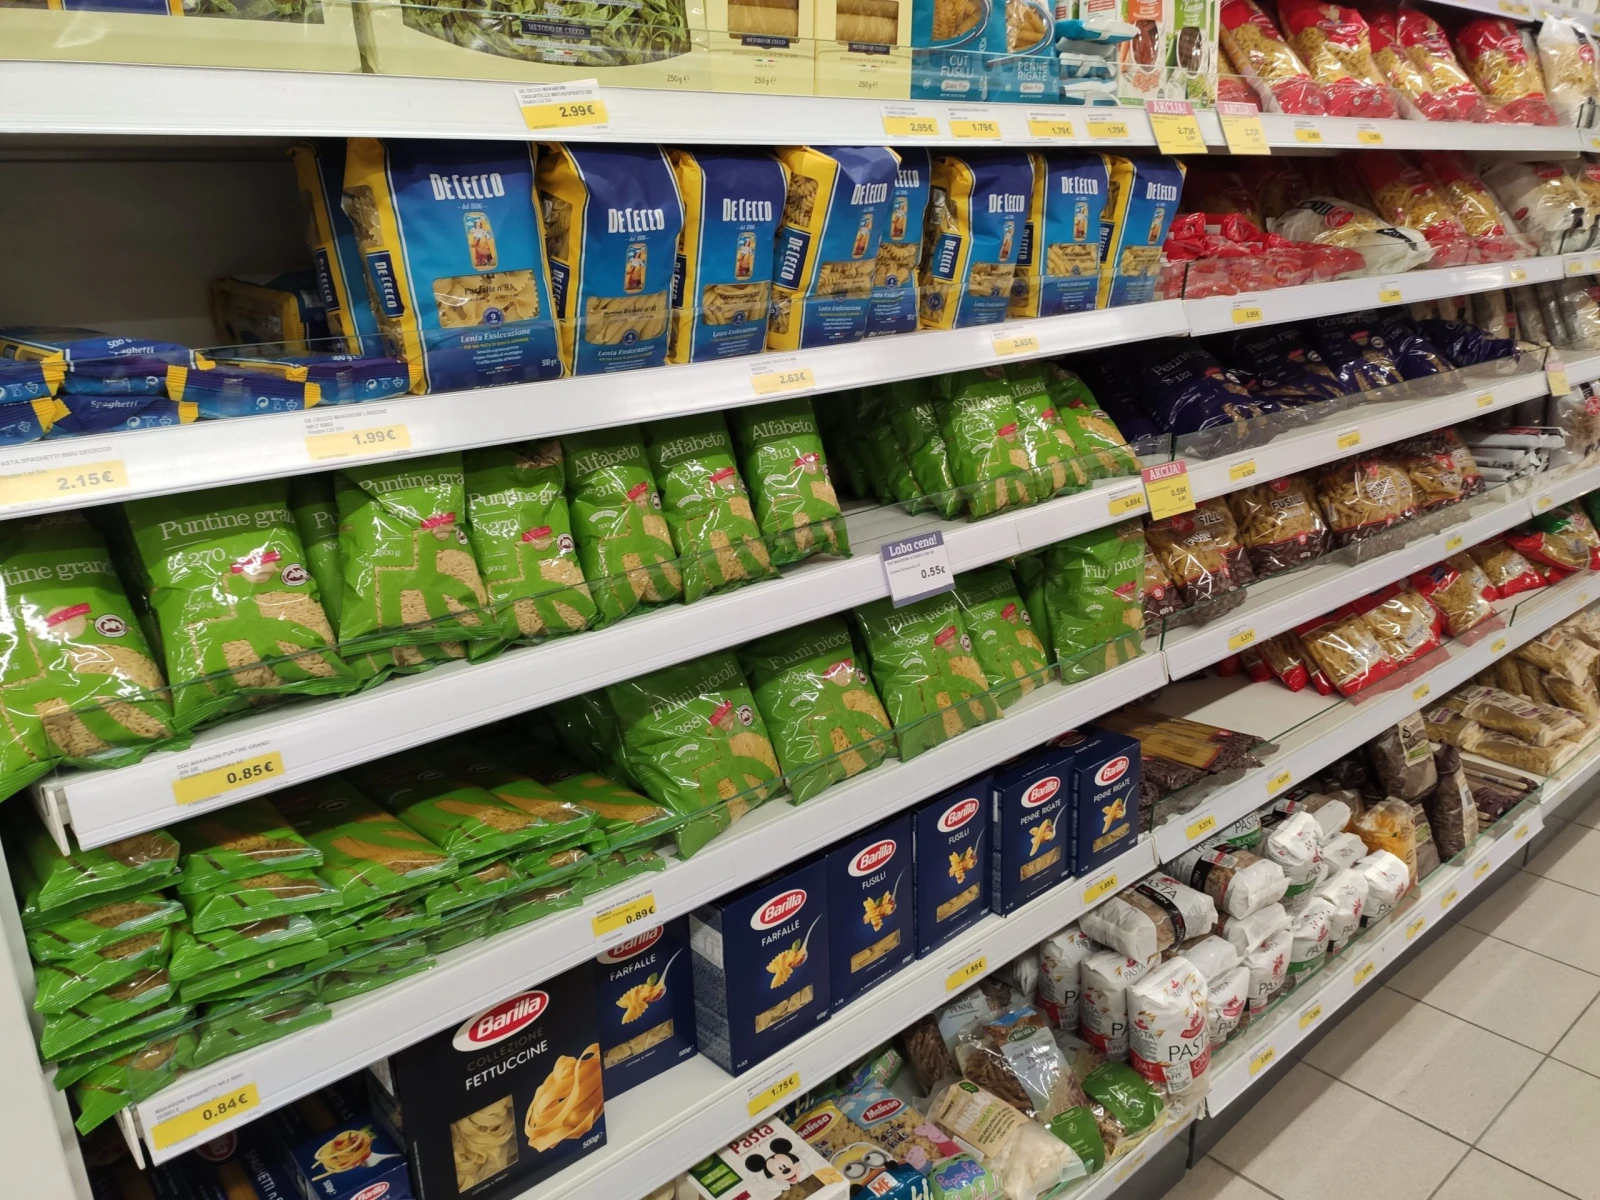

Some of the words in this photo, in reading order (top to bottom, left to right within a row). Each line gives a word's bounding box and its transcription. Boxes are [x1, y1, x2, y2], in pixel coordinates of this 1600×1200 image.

[949, 55, 969, 67] CUT
[1017, 61, 1048, 73] PENNE
[940, 65, 975, 79] FUSILLI
[1017, 71, 1048, 82] RIGATE
[559, 104, 595, 118] 2.99€
[1153, 101, 1188, 114] AKCIJA!
[460, 334, 483, 343] Lenta
[483, 328, 531, 341] Essiccazione
[90, 398, 138, 411] Spaghetti
[352, 429, 396, 446] 1.99€
[752, 420, 815, 440] Alfabeto
[659, 432, 726, 460] Alfabeto
[769, 448, 792, 461] 313
[20, 452, 61, 464] SPAGHETTI
[575, 445, 640, 478] Alfabeto
[56, 470, 115, 491] 2.15€
[1149, 462, 1182, 481] AKCIJA!
[467, 490, 537, 509] Puntine
[159, 512, 251, 541] Puntine
[888, 542, 914, 557] Laba
[913, 534, 938, 550] cena!
[650, 690, 696, 722] Filini
[688, 660, 738, 701] piccoli
[674, 716, 703, 736] 388
[226, 761, 274, 784] 0.85€
[1102, 758, 1128, 779] Barilla
[1029, 781, 1058, 803] Barilla
[1093, 785, 1112, 803] PENNE
[1112, 776, 1131, 793] RIGATE
[946, 803, 977, 826] Barilla
[1019, 807, 1041, 826] PENNE
[1041, 798, 1062, 816] RIGATE
[1234, 813, 1260, 834] PASTA
[948, 827, 971, 845] FUSILLI
[859, 846, 894, 873] Barilla
[861, 870, 887, 890] FUSILLI
[625, 905, 656, 925] 0.89€
[764, 893, 803, 922] Barilla
[761, 920, 801, 948] FARFALLE
[609, 953, 657, 982] FARFALLE
[1123, 962, 1147, 981] PASTA
[949, 1001, 975, 1014] PENNE
[475, 995, 542, 1041] Barilla
[466, 1027, 545, 1073] COLLEZIONE
[464, 1039, 549, 1092] FETTUCCINE
[1136, 1057, 1154, 1072] OAT
[770, 1077, 795, 1097] 1.75€
[156, 1107, 180, 1121] DOBELE
[202, 1092, 248, 1121] 0.84€
[866, 1099, 902, 1120] Melissa
[727, 1123, 775, 1156] Pasta
[887, 1132, 910, 1150] kids
[935, 1172, 970, 1189] Peppa
[960, 1161, 984, 1175] Pig
